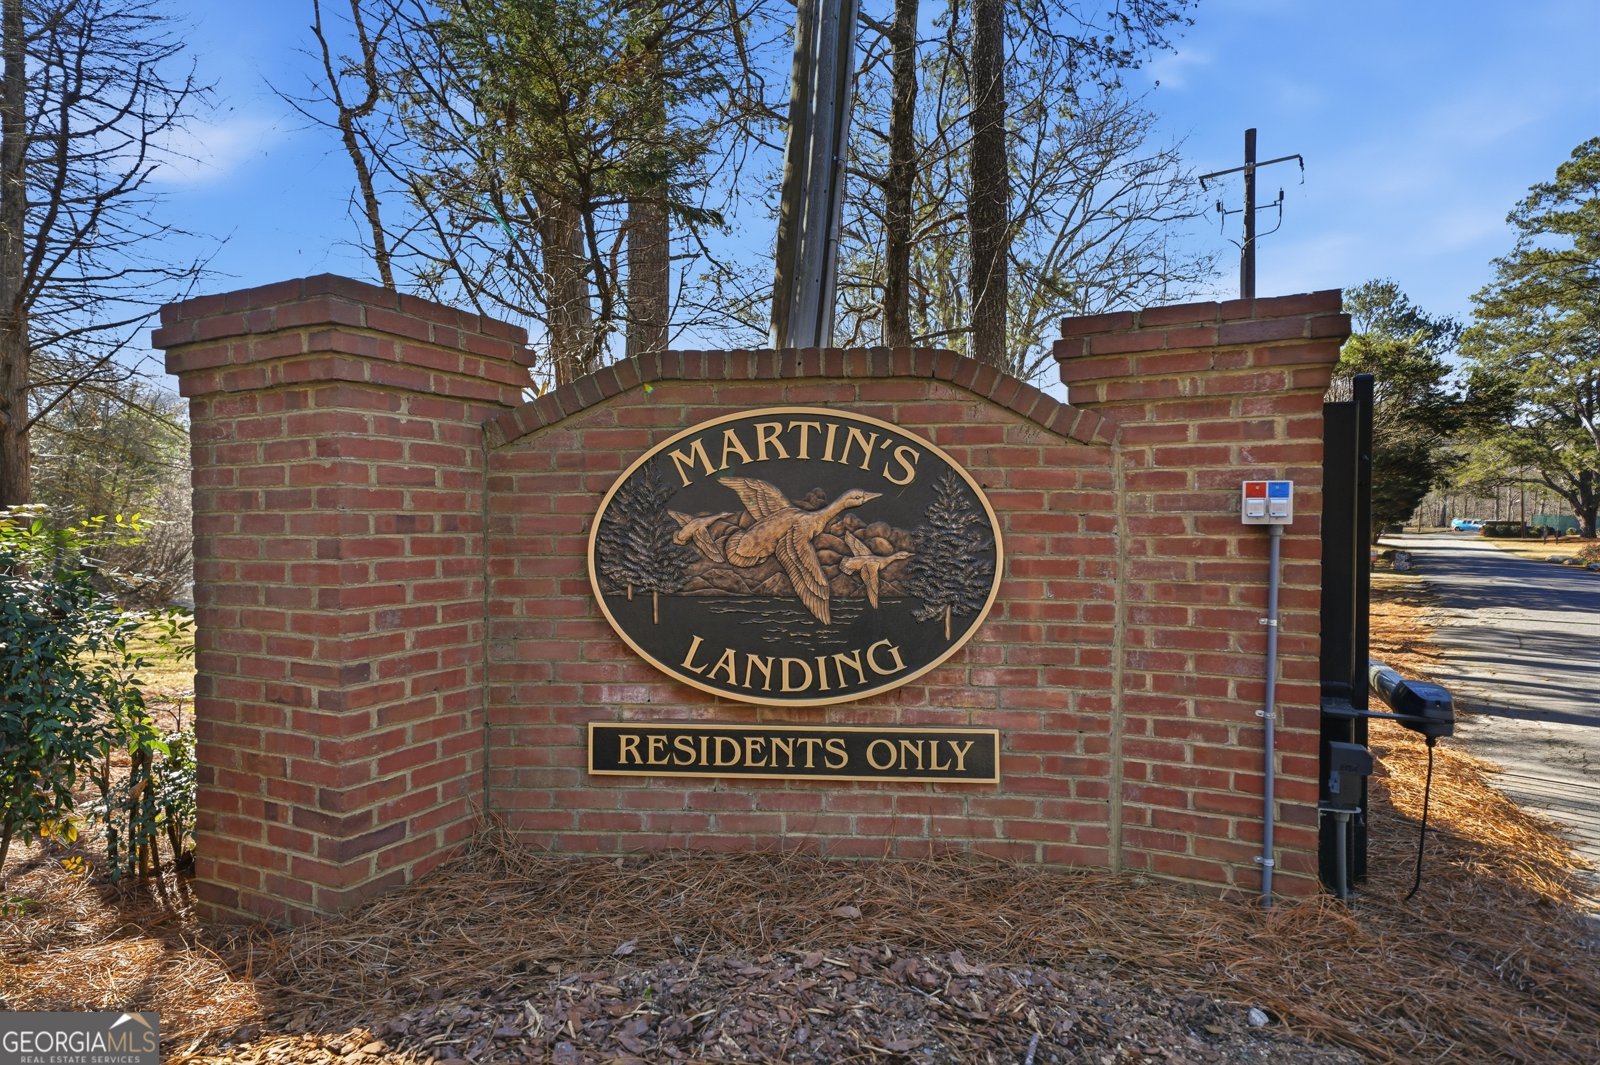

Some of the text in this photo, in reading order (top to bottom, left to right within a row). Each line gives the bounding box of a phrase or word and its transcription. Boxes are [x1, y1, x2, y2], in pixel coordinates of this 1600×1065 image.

[668, 421, 920, 488] MARTIN'S
[680, 635, 908, 693] LANDING
[618, 734, 975, 771] RESIDENTS ONLY
